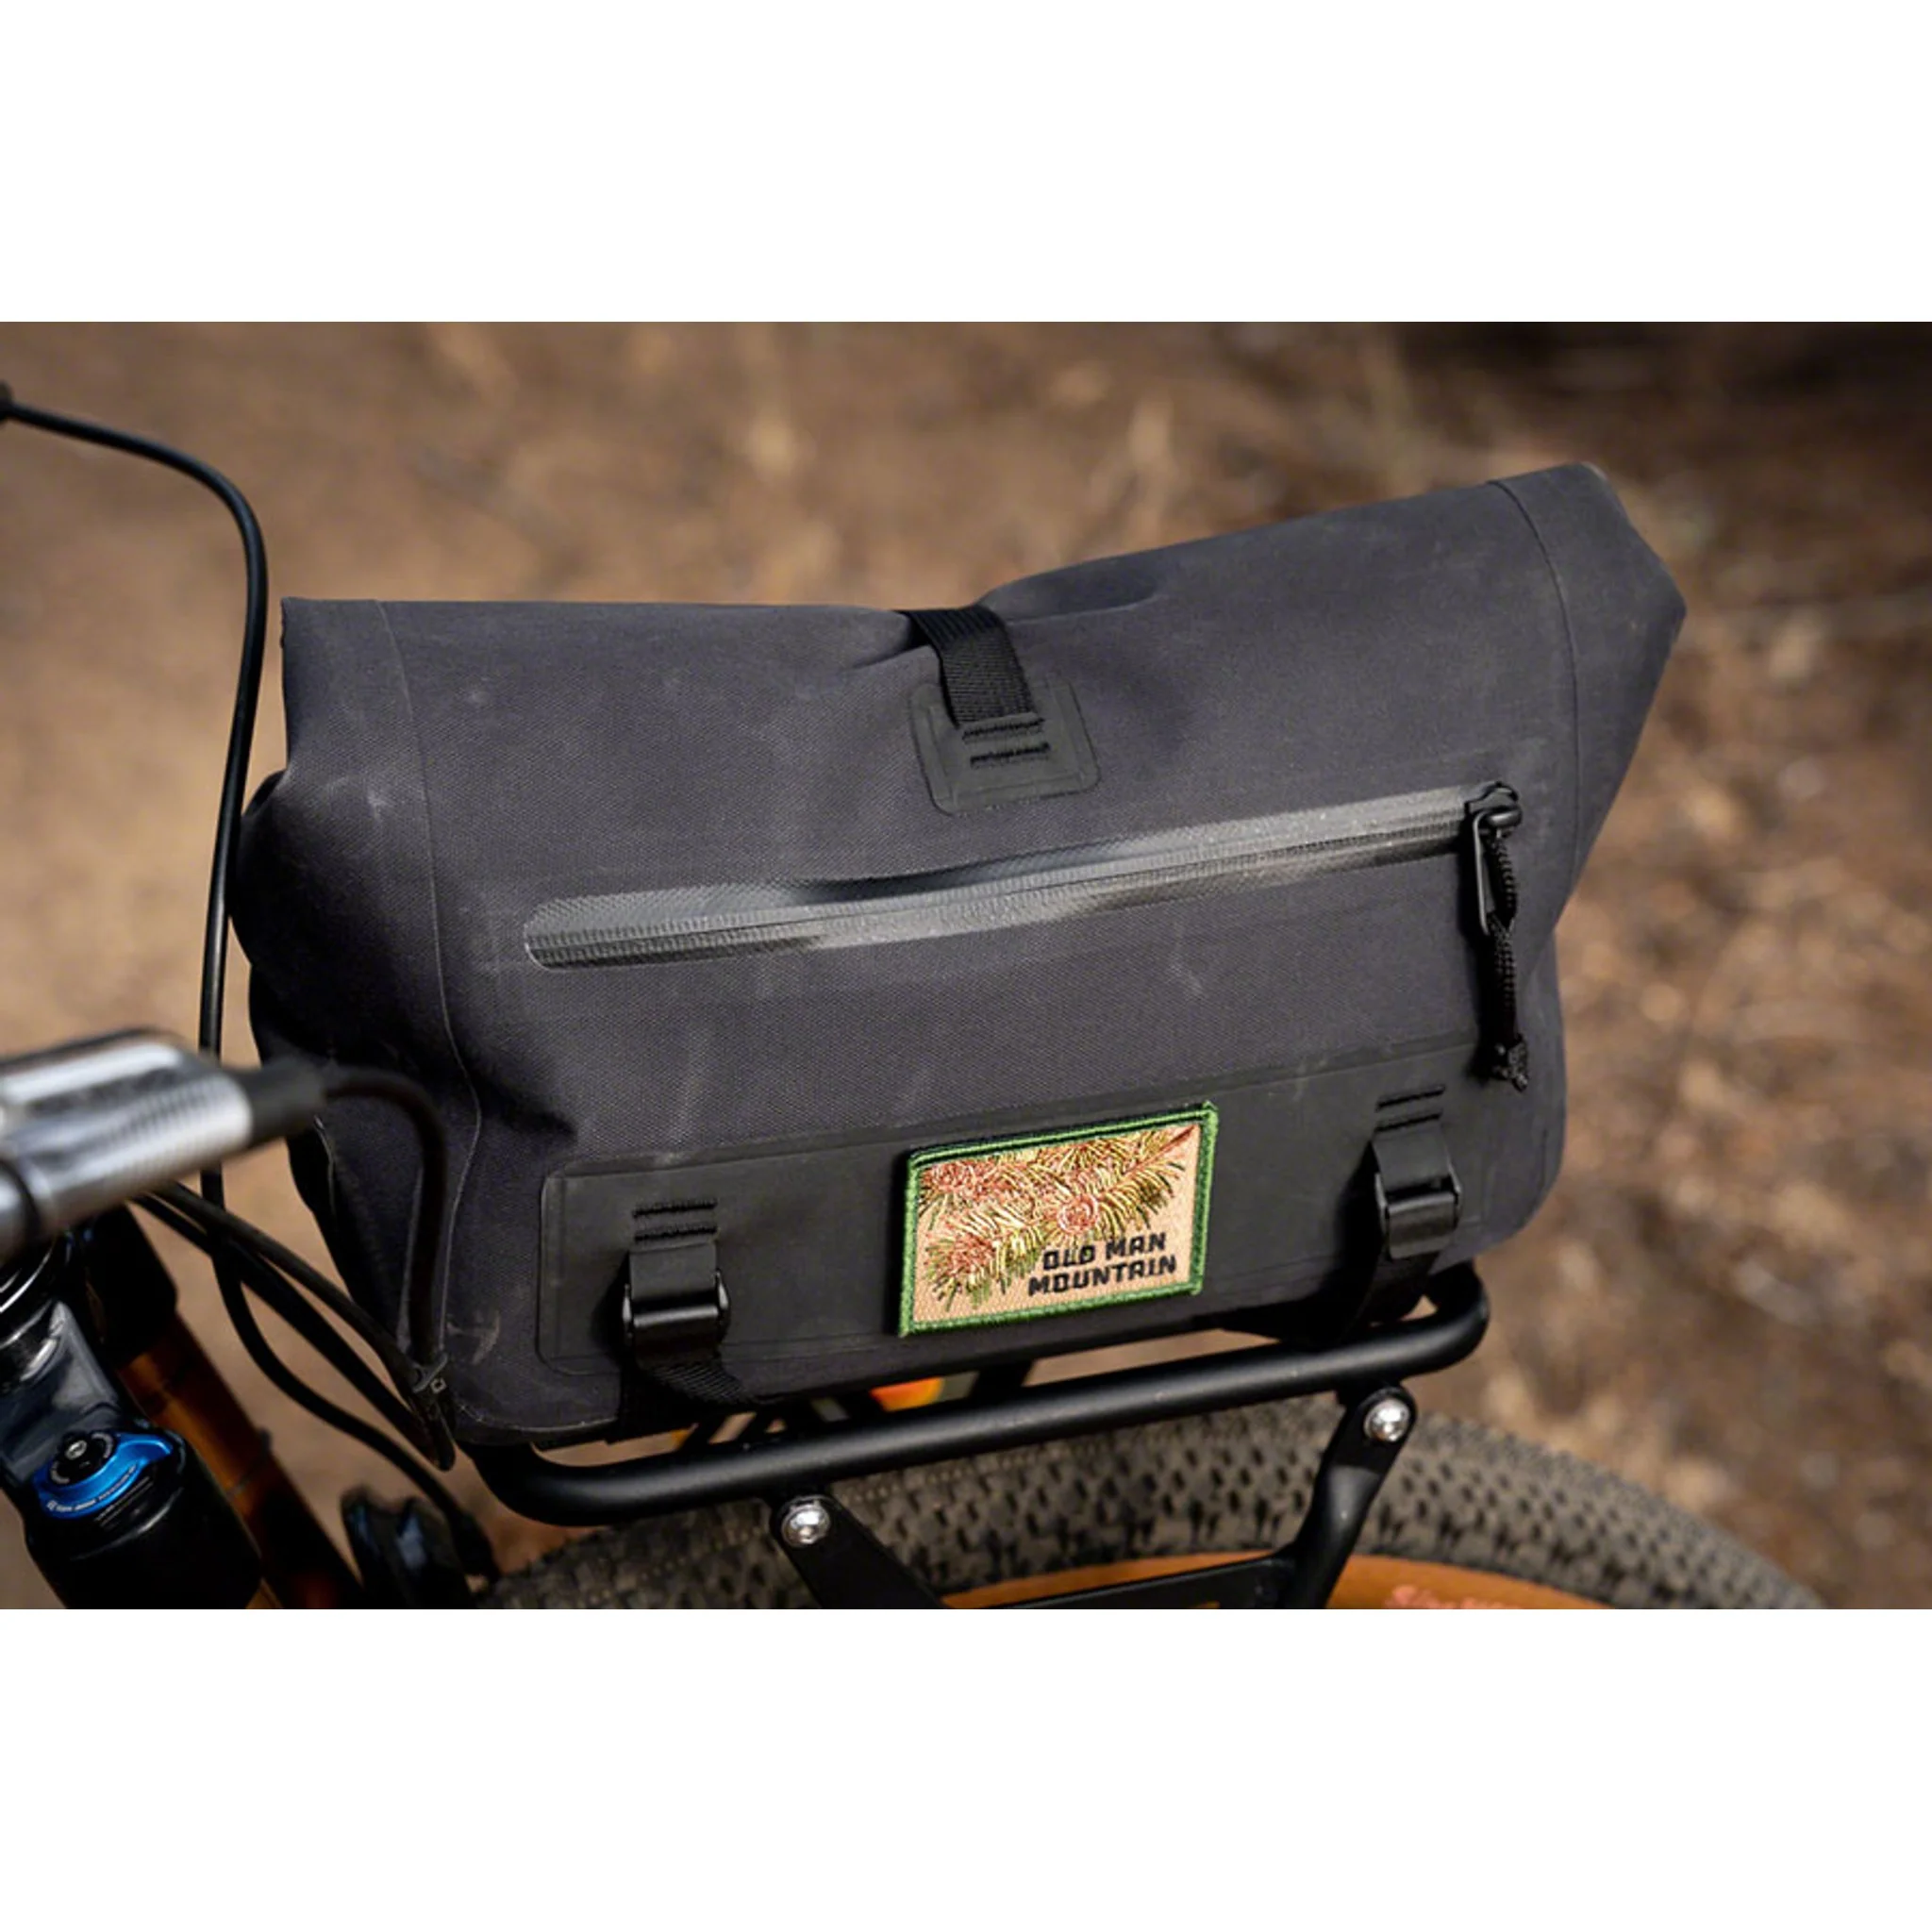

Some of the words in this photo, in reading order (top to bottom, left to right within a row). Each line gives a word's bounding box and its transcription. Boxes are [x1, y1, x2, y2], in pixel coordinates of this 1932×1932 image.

[1042, 1244, 1095, 1271] OLD
[1105, 1232, 1166, 1260] MAN
[1028, 1255, 1176, 1296] MOUNTAIN
